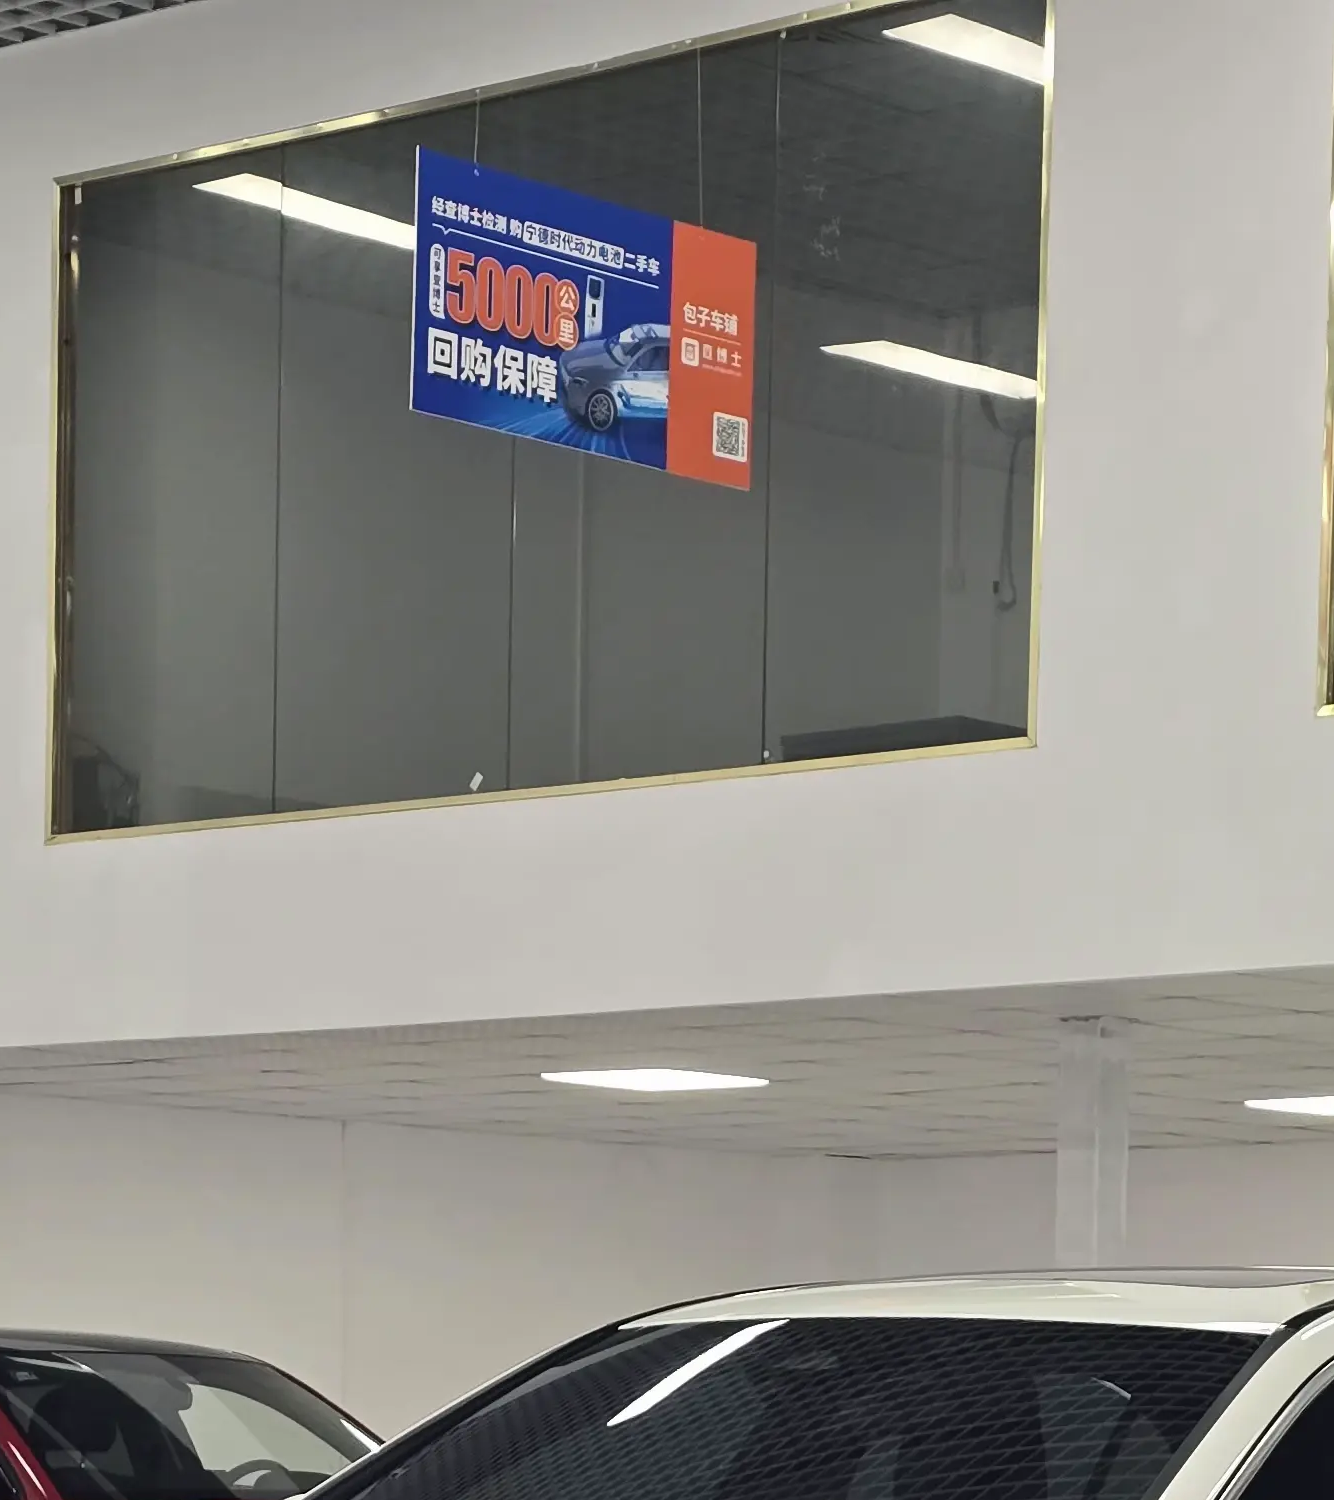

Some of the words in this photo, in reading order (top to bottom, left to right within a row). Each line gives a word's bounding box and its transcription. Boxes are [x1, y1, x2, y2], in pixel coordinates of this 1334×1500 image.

[446, 247, 561, 347] 5000
[427, 327, 558, 403] 回购保障
